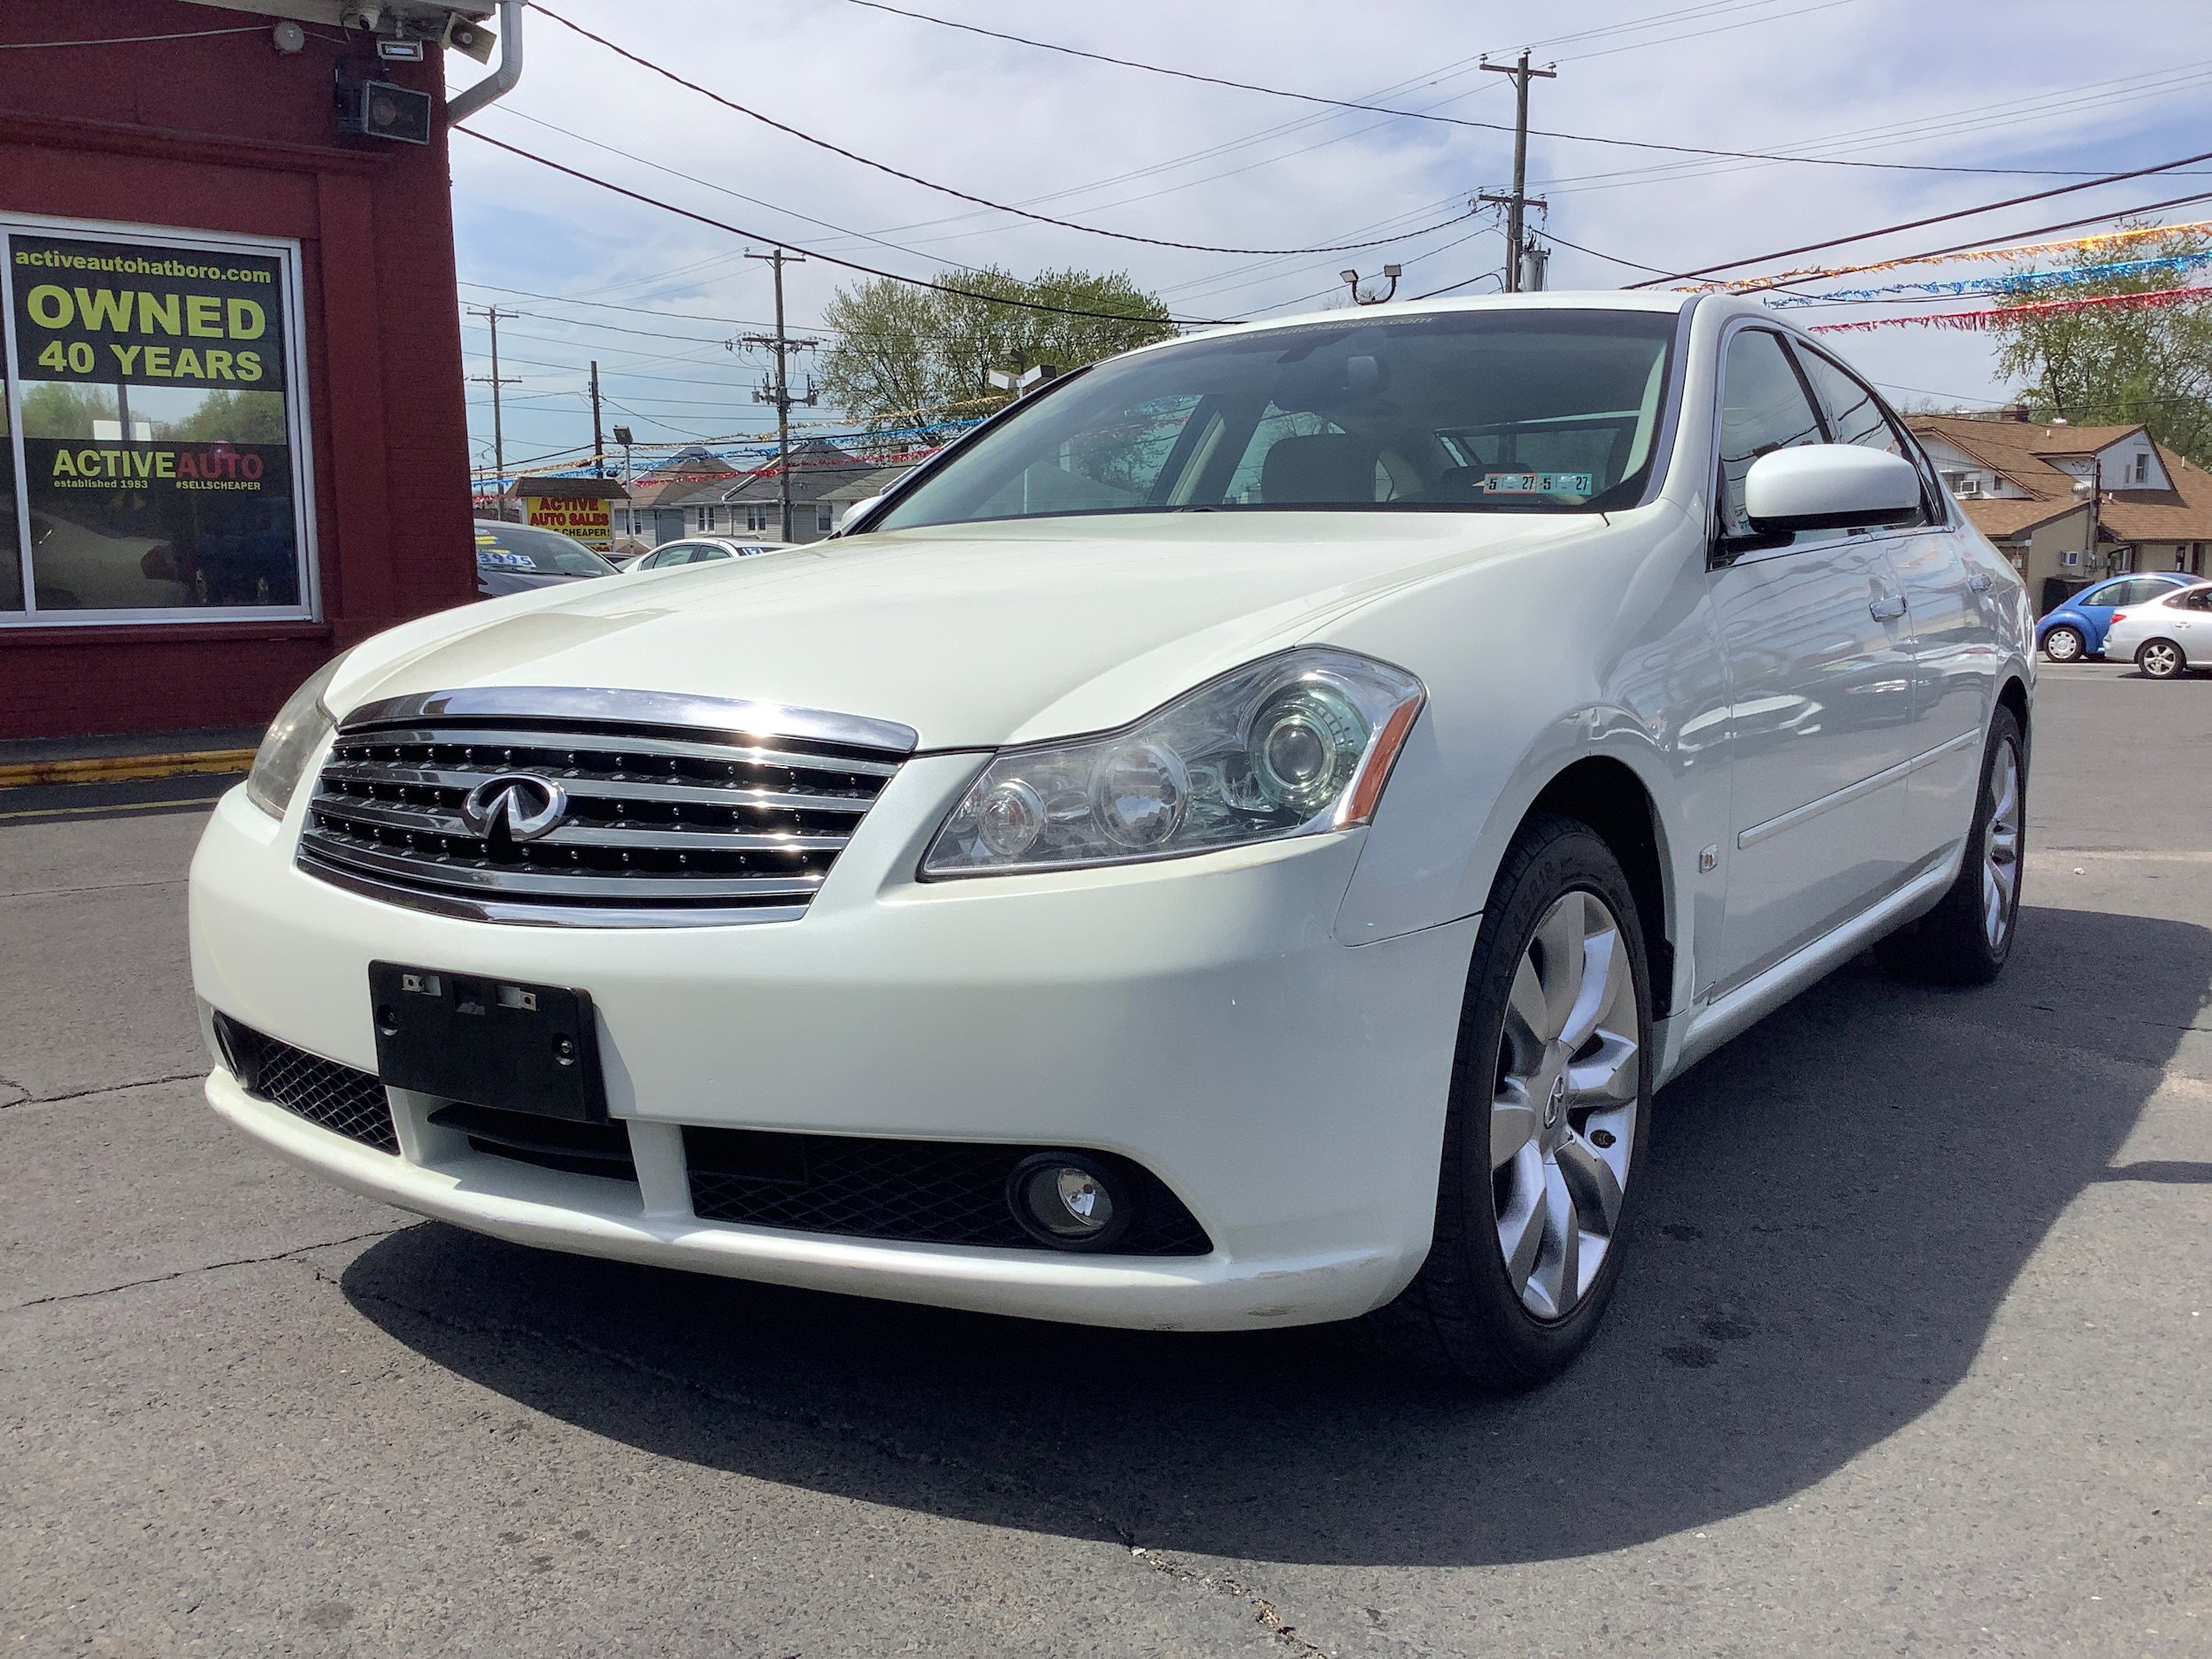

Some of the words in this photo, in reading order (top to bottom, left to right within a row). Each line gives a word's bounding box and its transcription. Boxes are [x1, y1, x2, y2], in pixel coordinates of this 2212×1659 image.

[15, 250, 272, 283] activeautohatboro.com
[27, 285, 266, 341] OWNED
[38, 341, 96, 373] 40
[109, 344, 264, 381] YEARS
[53, 479, 117, 488] established
[120, 480, 149, 488] 1983
[176, 480, 261, 491] #SELLSCHEAPER
[1522, 476, 1534, 490] 27
[1576, 476, 1588, 491] 27
[539, 497, 599, 511] ACTIVE
[531, 513, 566, 526] AUTO
[569, 513, 609, 526] SALES
